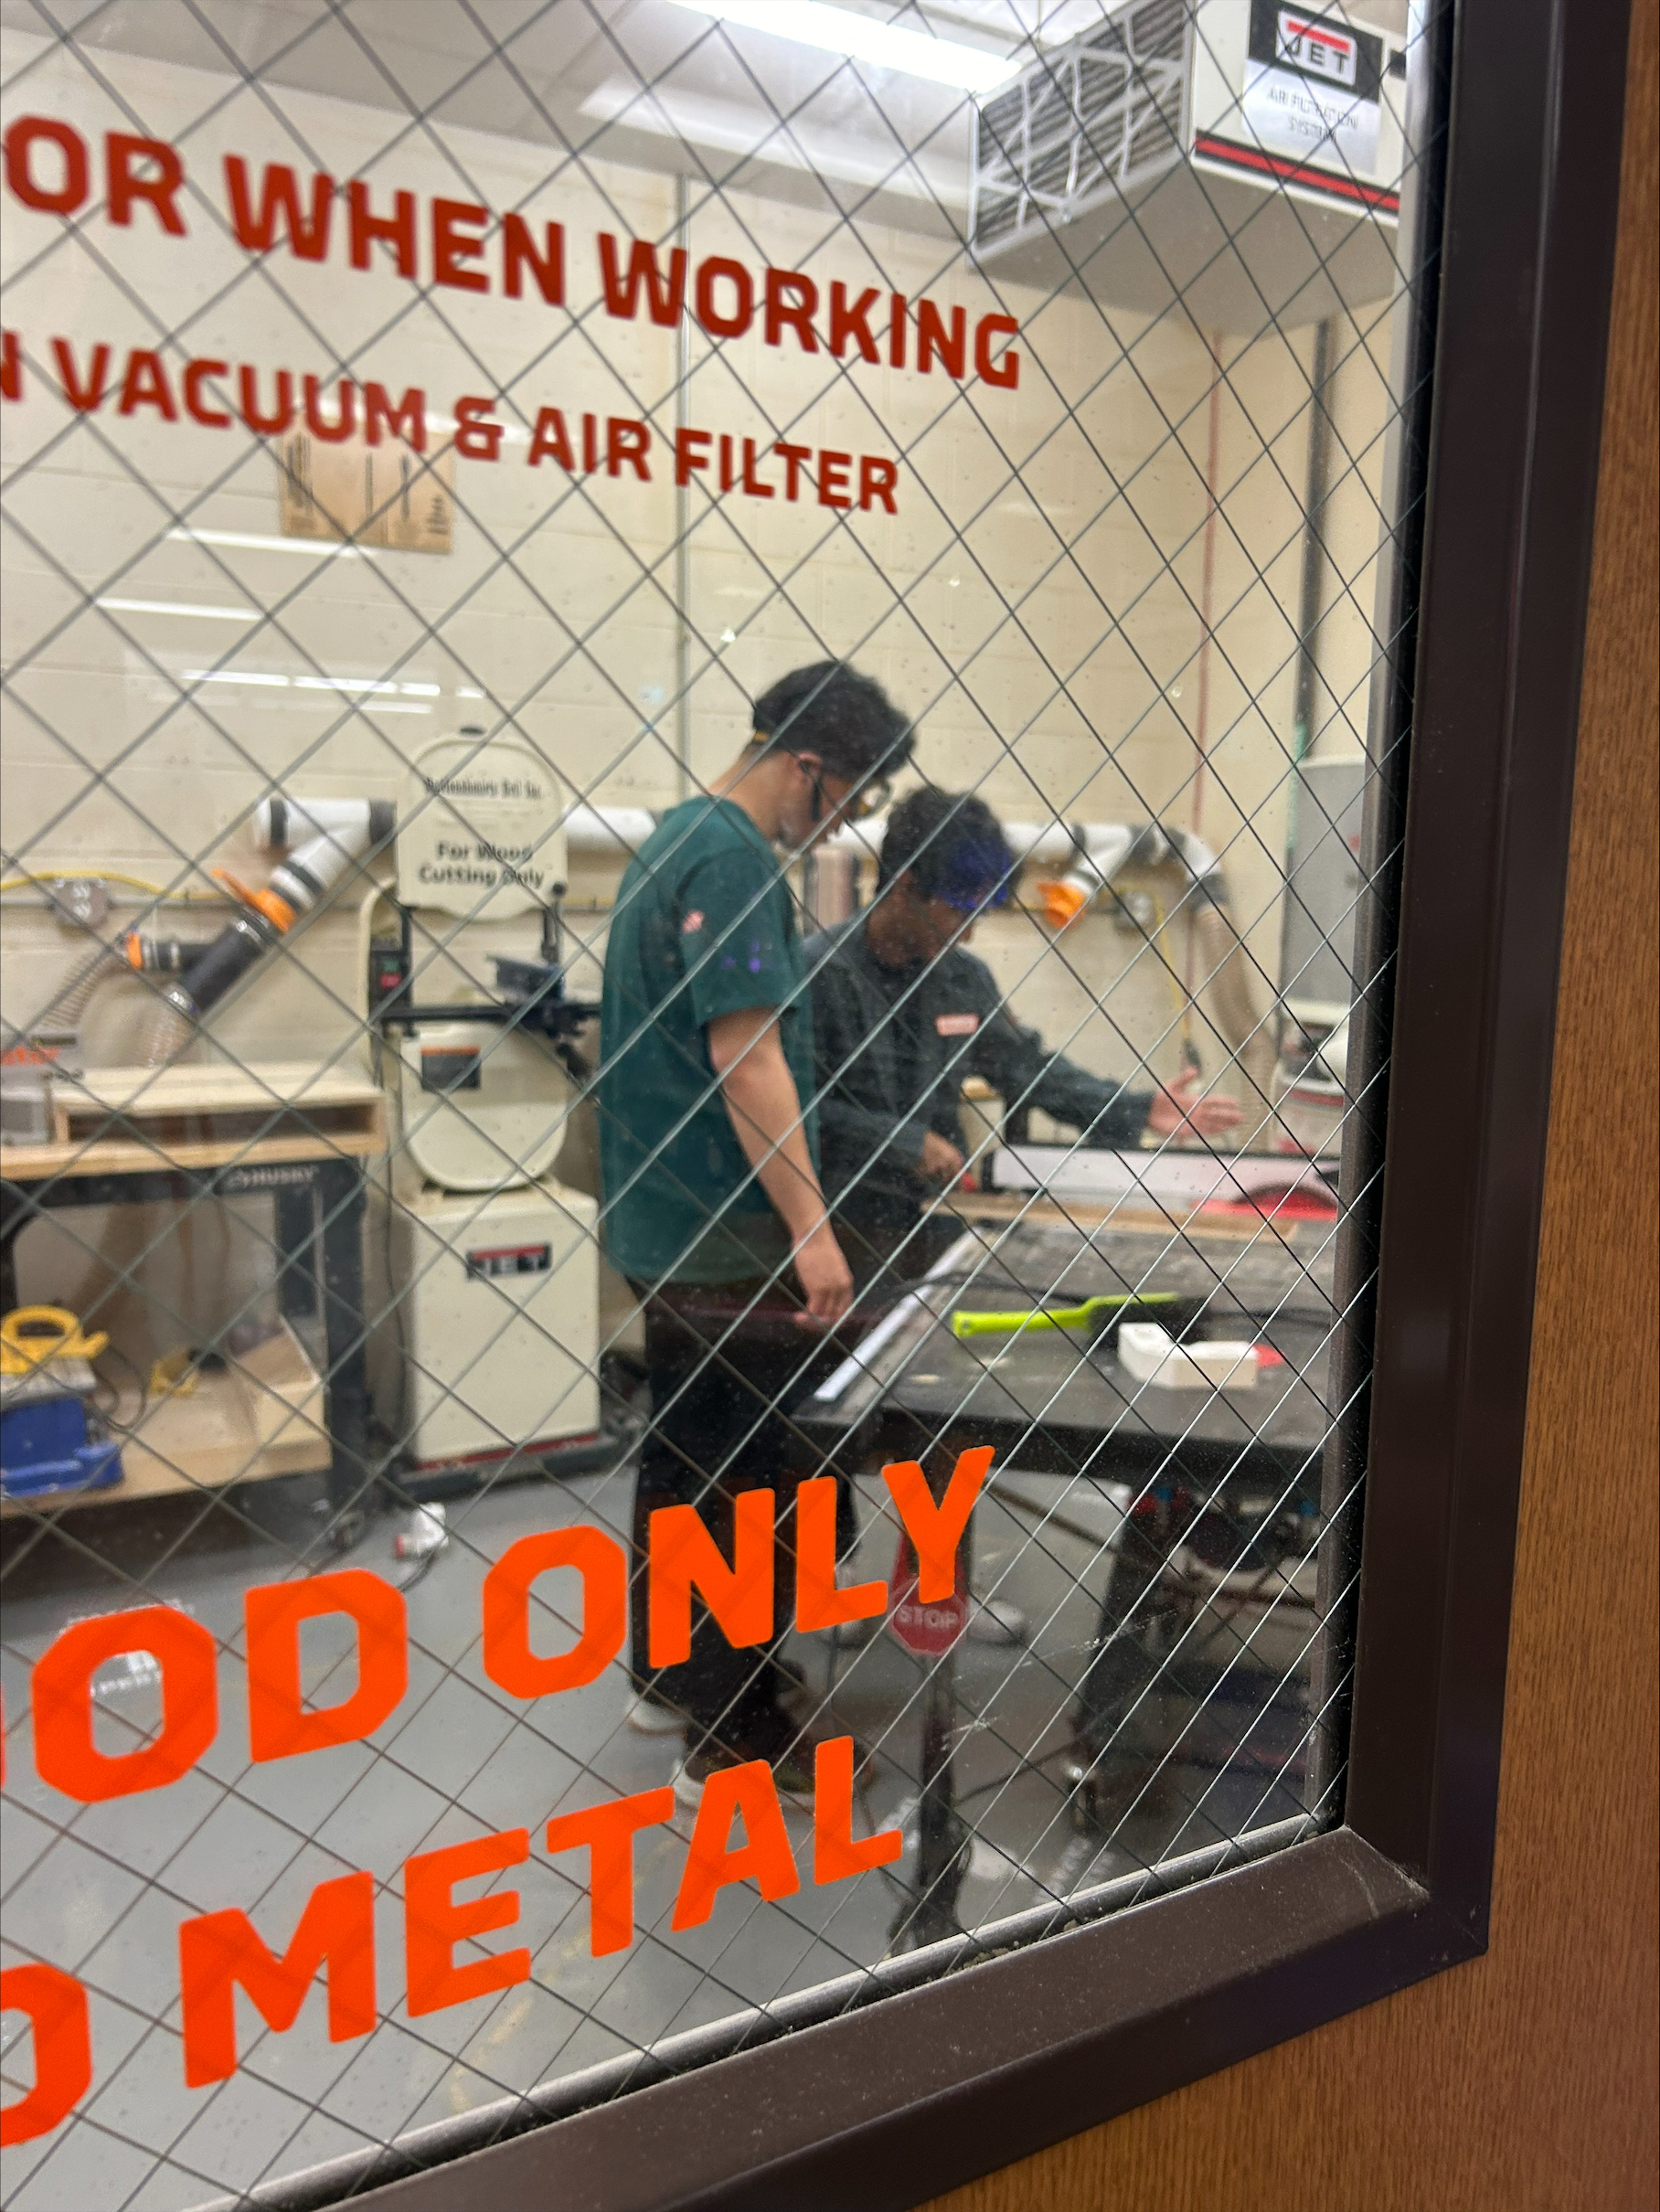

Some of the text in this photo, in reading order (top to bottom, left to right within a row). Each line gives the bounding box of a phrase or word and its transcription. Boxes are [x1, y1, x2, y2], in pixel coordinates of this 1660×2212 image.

[1285, 35, 1350, 75] JET
[5, 116, 1019, 390] OR WHEN WORKING
[52, 336, 427, 453] VACUUM
[455, 397, 505, 461] &
[527, 407, 652, 482] AIR
[676, 427, 899, 516] FILTER
[419, 865, 496, 888] Cutting
[437, 842, 469, 858] For
[481, 1445, 995, 1701] ONLY
[896, 1604, 959, 1631] STOP
[178, 1735, 904, 2090] METAL
